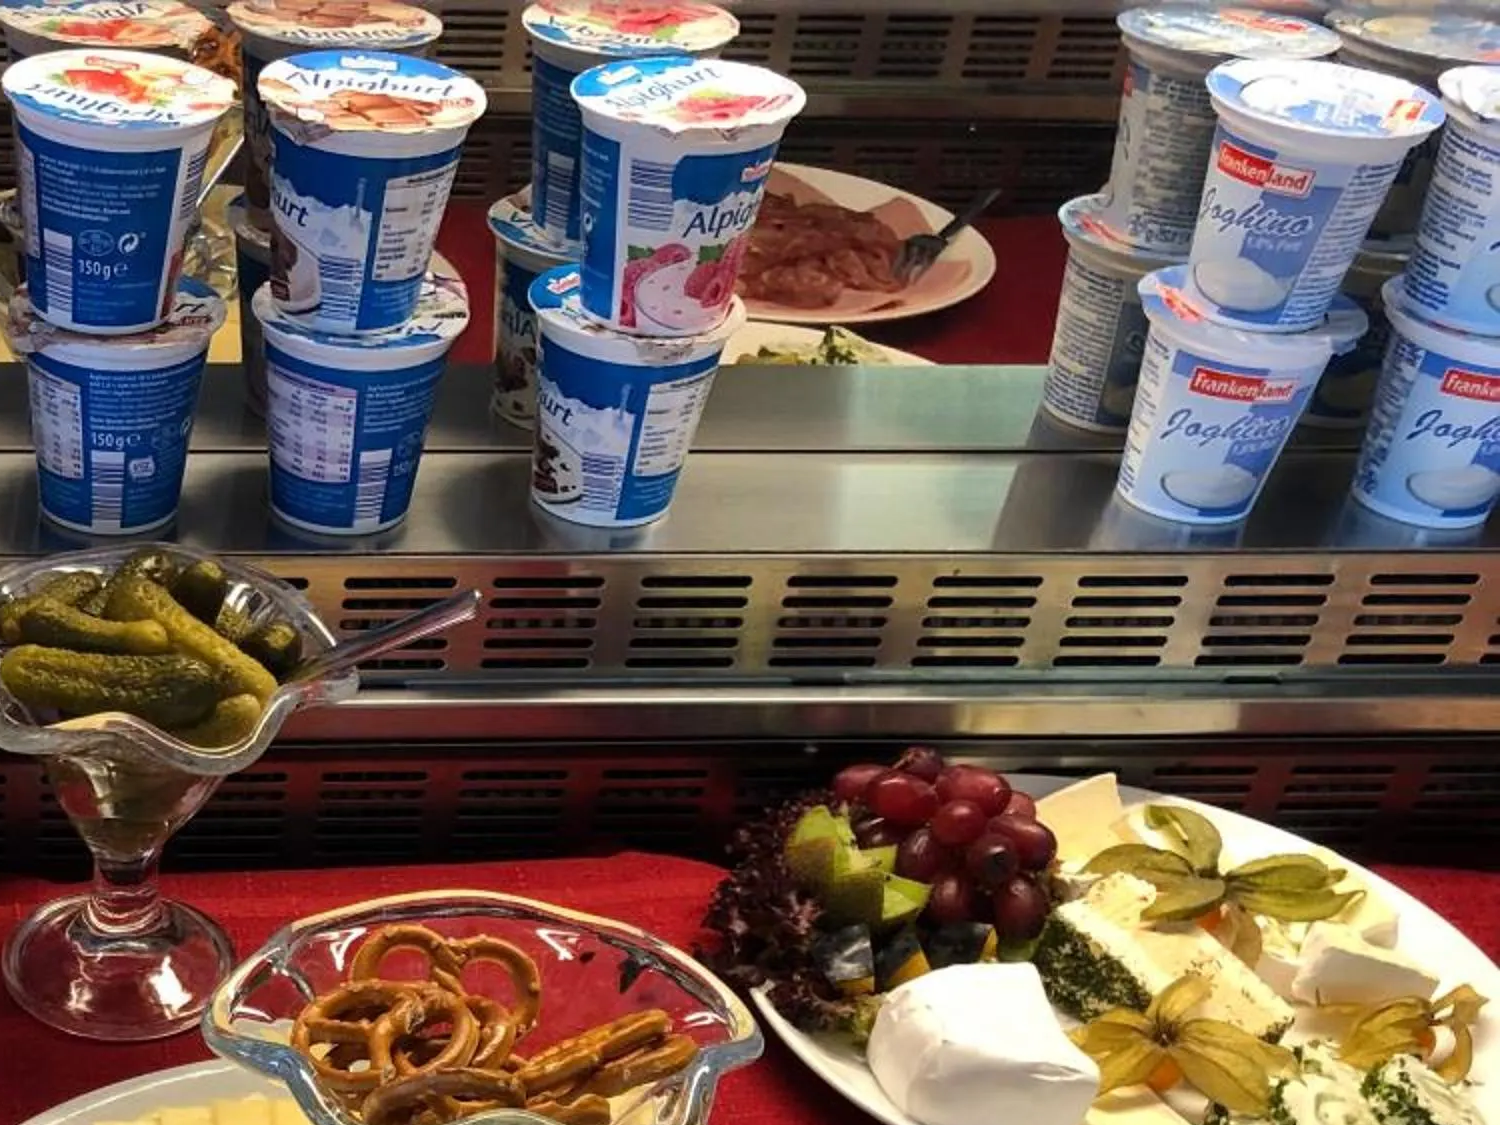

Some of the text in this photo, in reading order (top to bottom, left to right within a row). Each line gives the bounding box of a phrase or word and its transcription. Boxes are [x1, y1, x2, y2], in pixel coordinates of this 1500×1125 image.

[286, 70, 455, 97] Alpighurt
[1219, 147, 1310, 190] Frankenland
[1193, 371, 1294, 398] Frankenland
